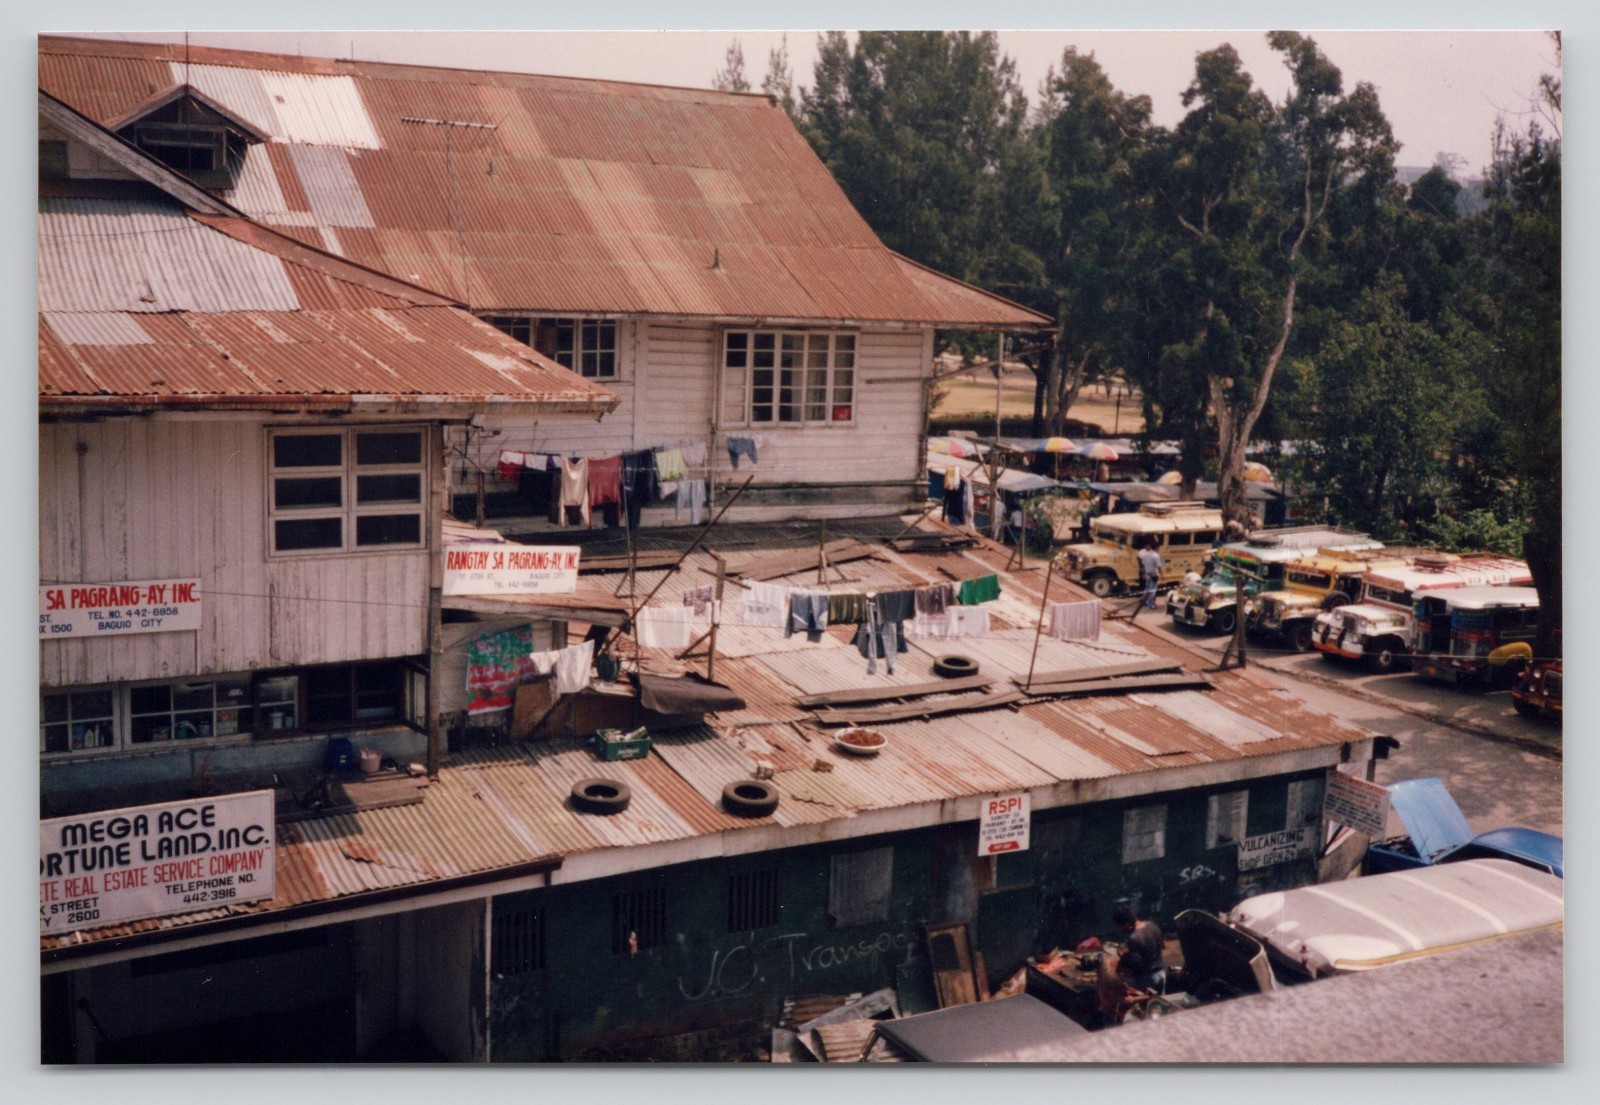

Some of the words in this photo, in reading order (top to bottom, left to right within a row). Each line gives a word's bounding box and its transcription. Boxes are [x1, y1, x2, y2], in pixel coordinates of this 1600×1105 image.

[447, 551, 489, 570] RANGTAY
[492, 551, 504, 570] SA
[46, 589, 66, 610] SA
[172, 583, 200, 603] INC.
[39, 614, 52, 623] ST.
[108, 609, 123, 619] NO.
[51, 623, 73, 633] 1500
[98, 620, 132, 630] BAGUIO
[141, 618, 163, 628] CITY
[989, 797, 1022, 815] RSPI
[61, 814, 149, 847] MEGA
[158, 804, 216, 833] ACE
[1238, 829, 1305, 852] VULCANIZING
[1240, 856, 1260, 870] SHOP
[1264, 852, 1284, 866] OPEN
[65, 877, 99, 898] REAL
[104, 867, 148, 893] ESTATE
[153, 858, 204, 884] SERVICE
[50, 897, 99, 914] STREET
[165, 876, 234, 895] TELEPHONE
[238, 873, 256, 884] NO.
[67, 909, 100, 924] 2600
[183, 887, 237, 905] 442-3916
